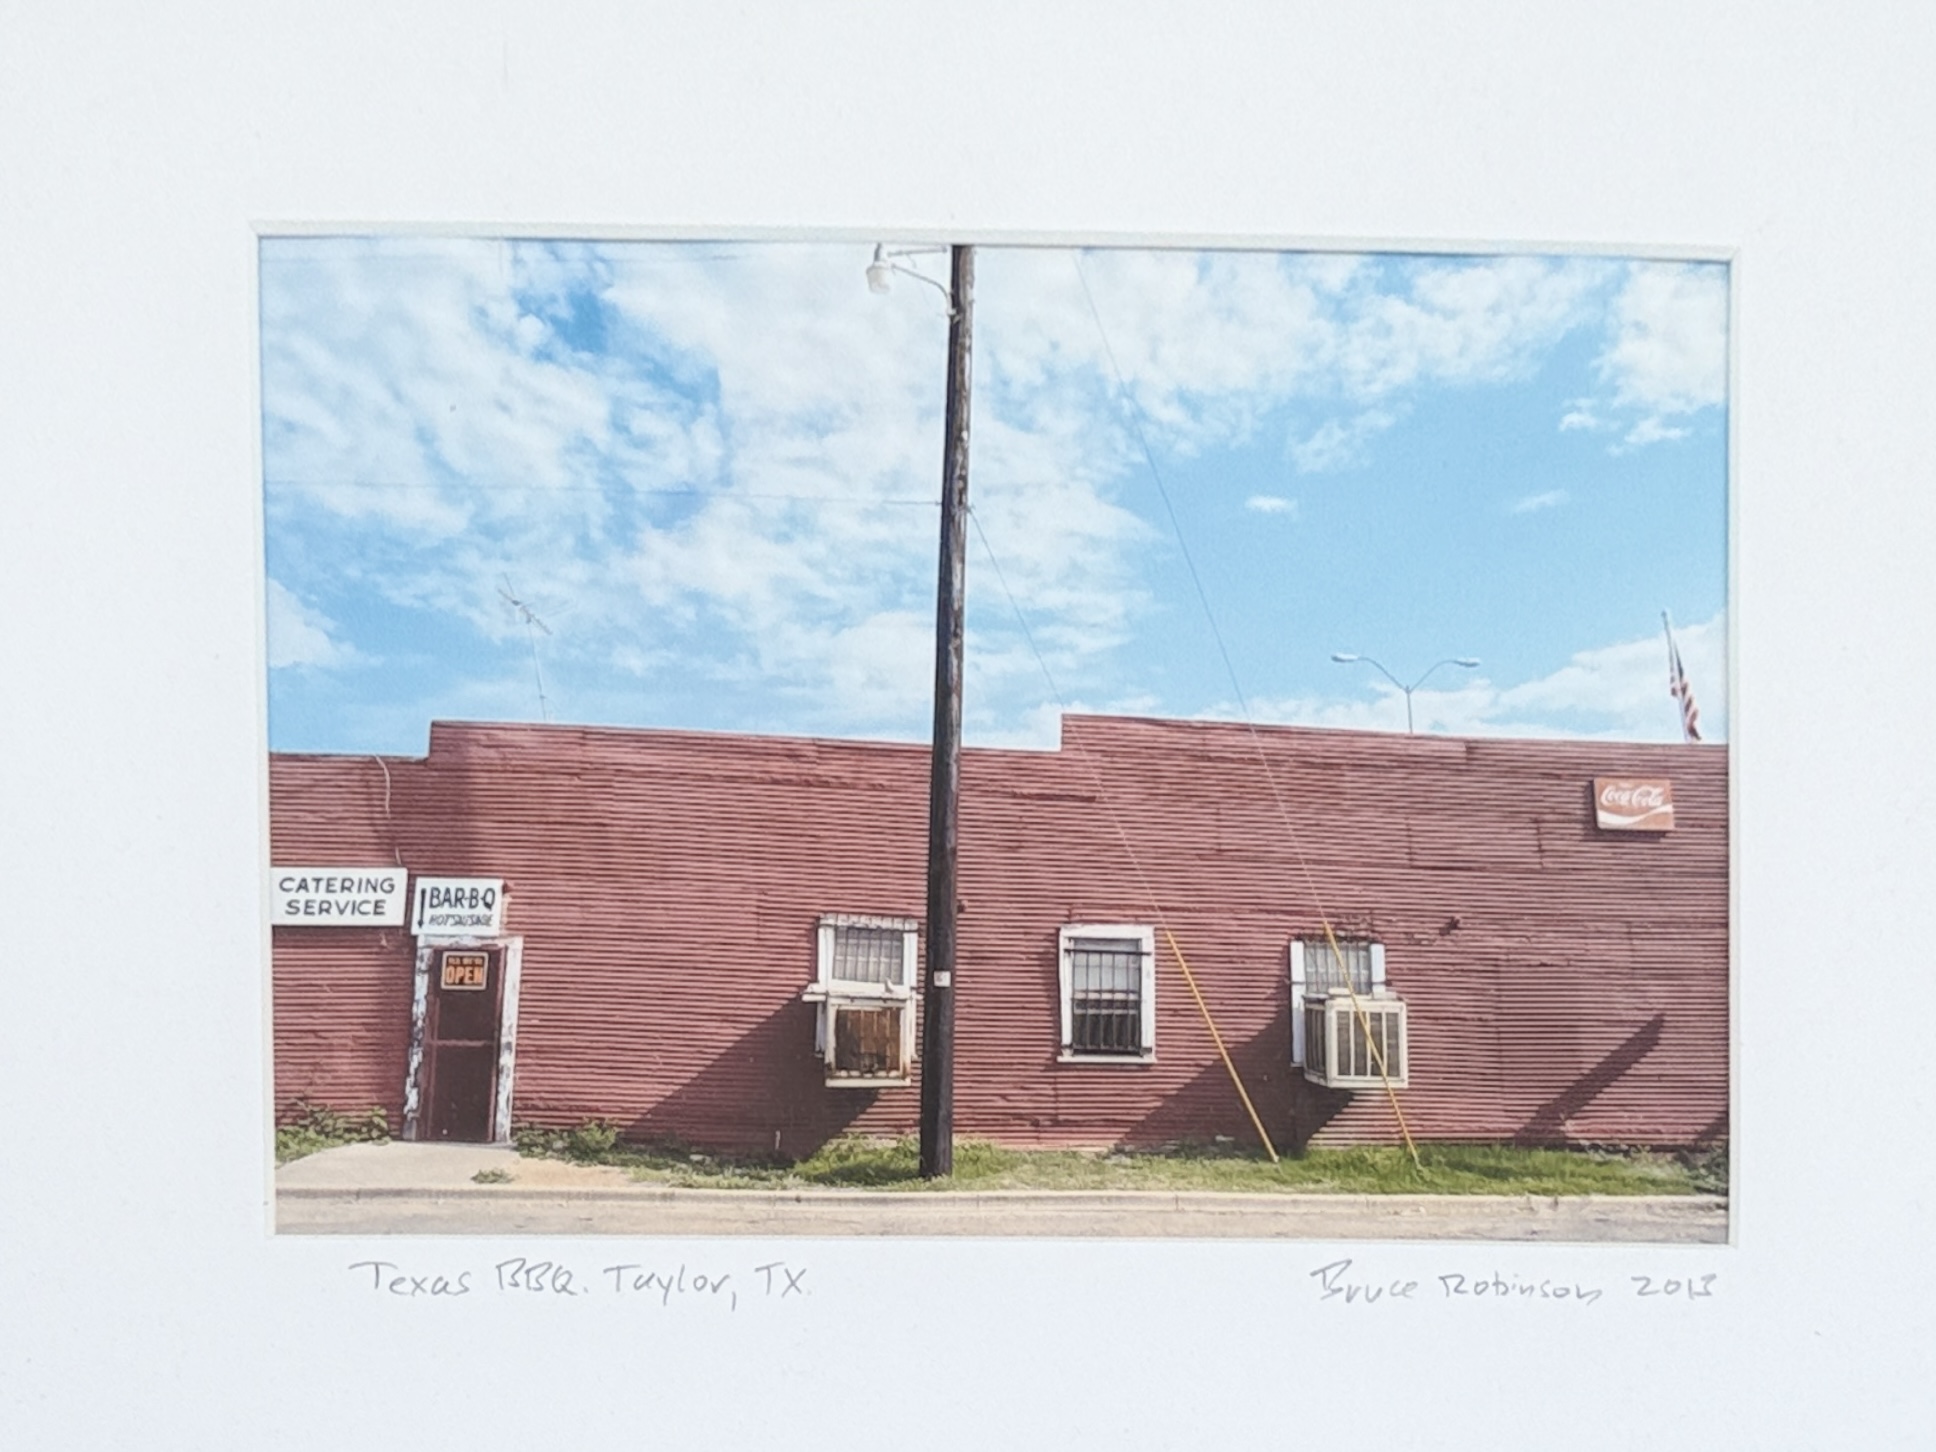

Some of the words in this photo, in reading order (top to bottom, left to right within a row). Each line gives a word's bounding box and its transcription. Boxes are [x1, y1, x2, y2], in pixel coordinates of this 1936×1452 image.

[279, 877, 395, 893] CATERING
[285, 899, 386, 916] SERVICE
[445, 966, 484, 984] OPEN
[348, 1261, 471, 1296] Texas
[603, 1263, 737, 1311] Taylor,
[1310, 1259, 1418, 1303] Bruce
[1438, 1271, 1602, 1306] Robinson
